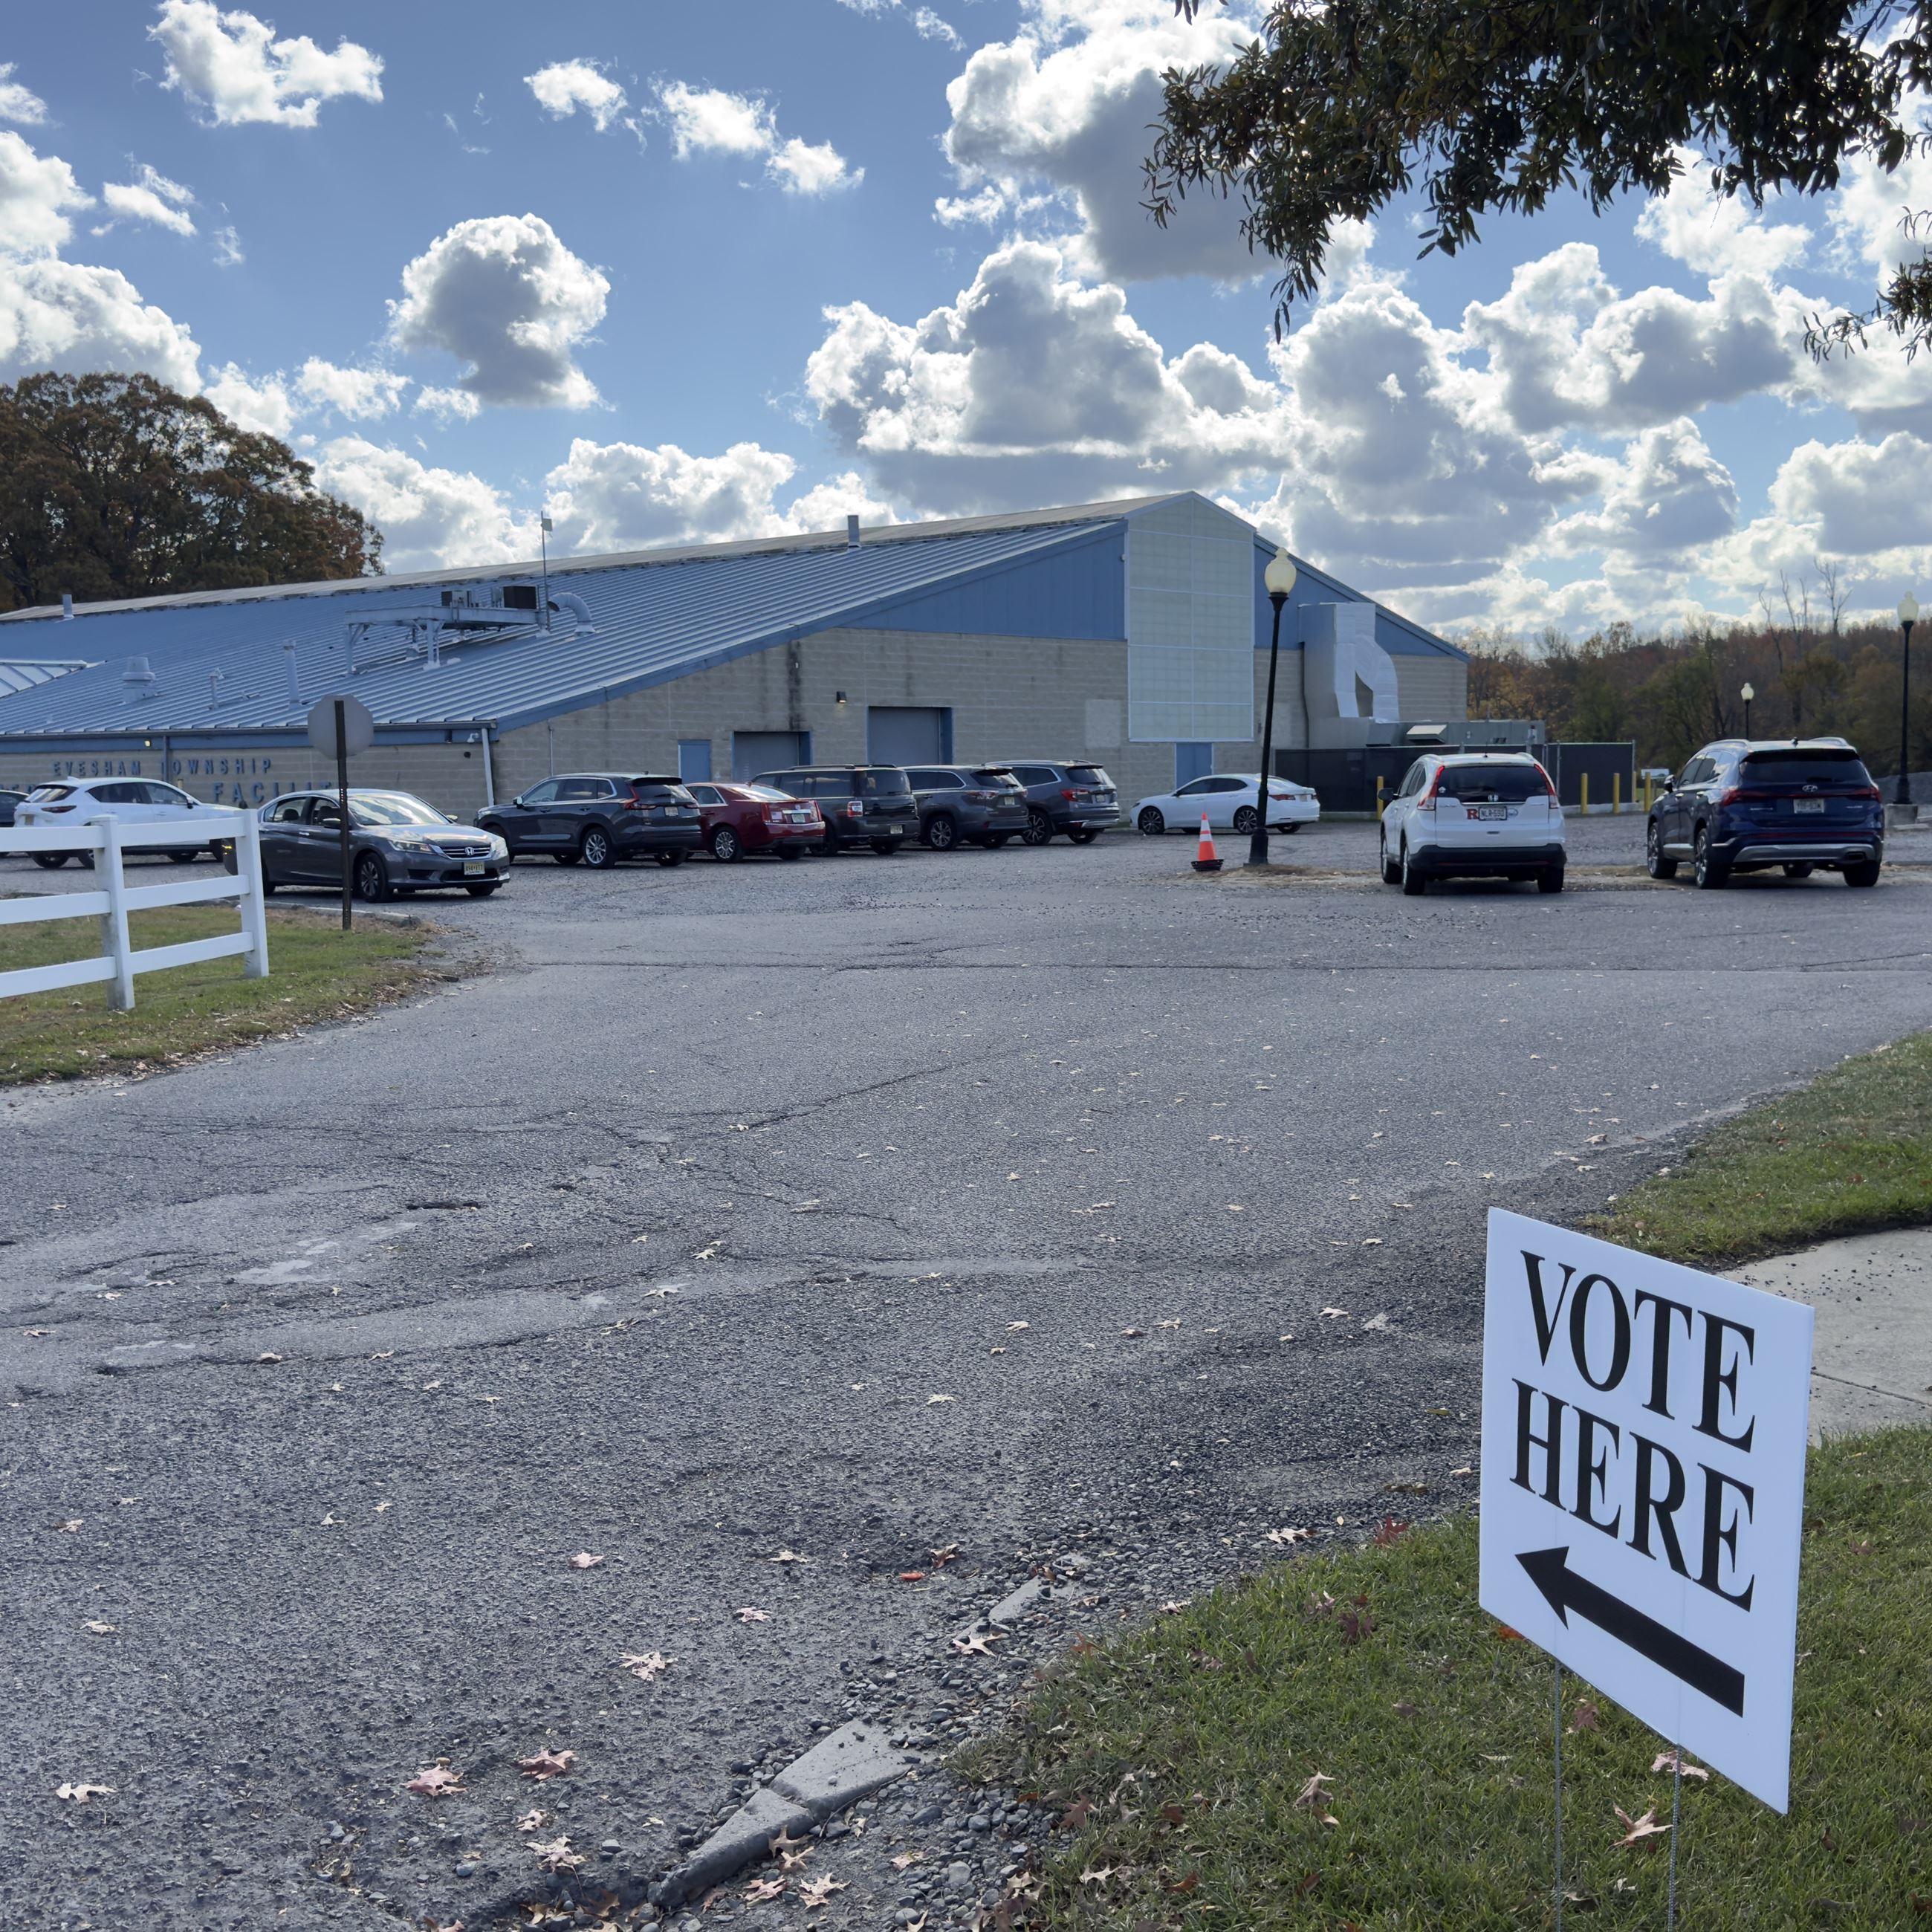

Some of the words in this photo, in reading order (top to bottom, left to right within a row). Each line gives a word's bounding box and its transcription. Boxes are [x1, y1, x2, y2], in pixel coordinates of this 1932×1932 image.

[53, 760, 141, 777] EVESHAM
[1467, 808, 1479, 820] R
[1520, 1250, 1755, 1453] VOTE
[1509, 1378, 1754, 1612] HERE
